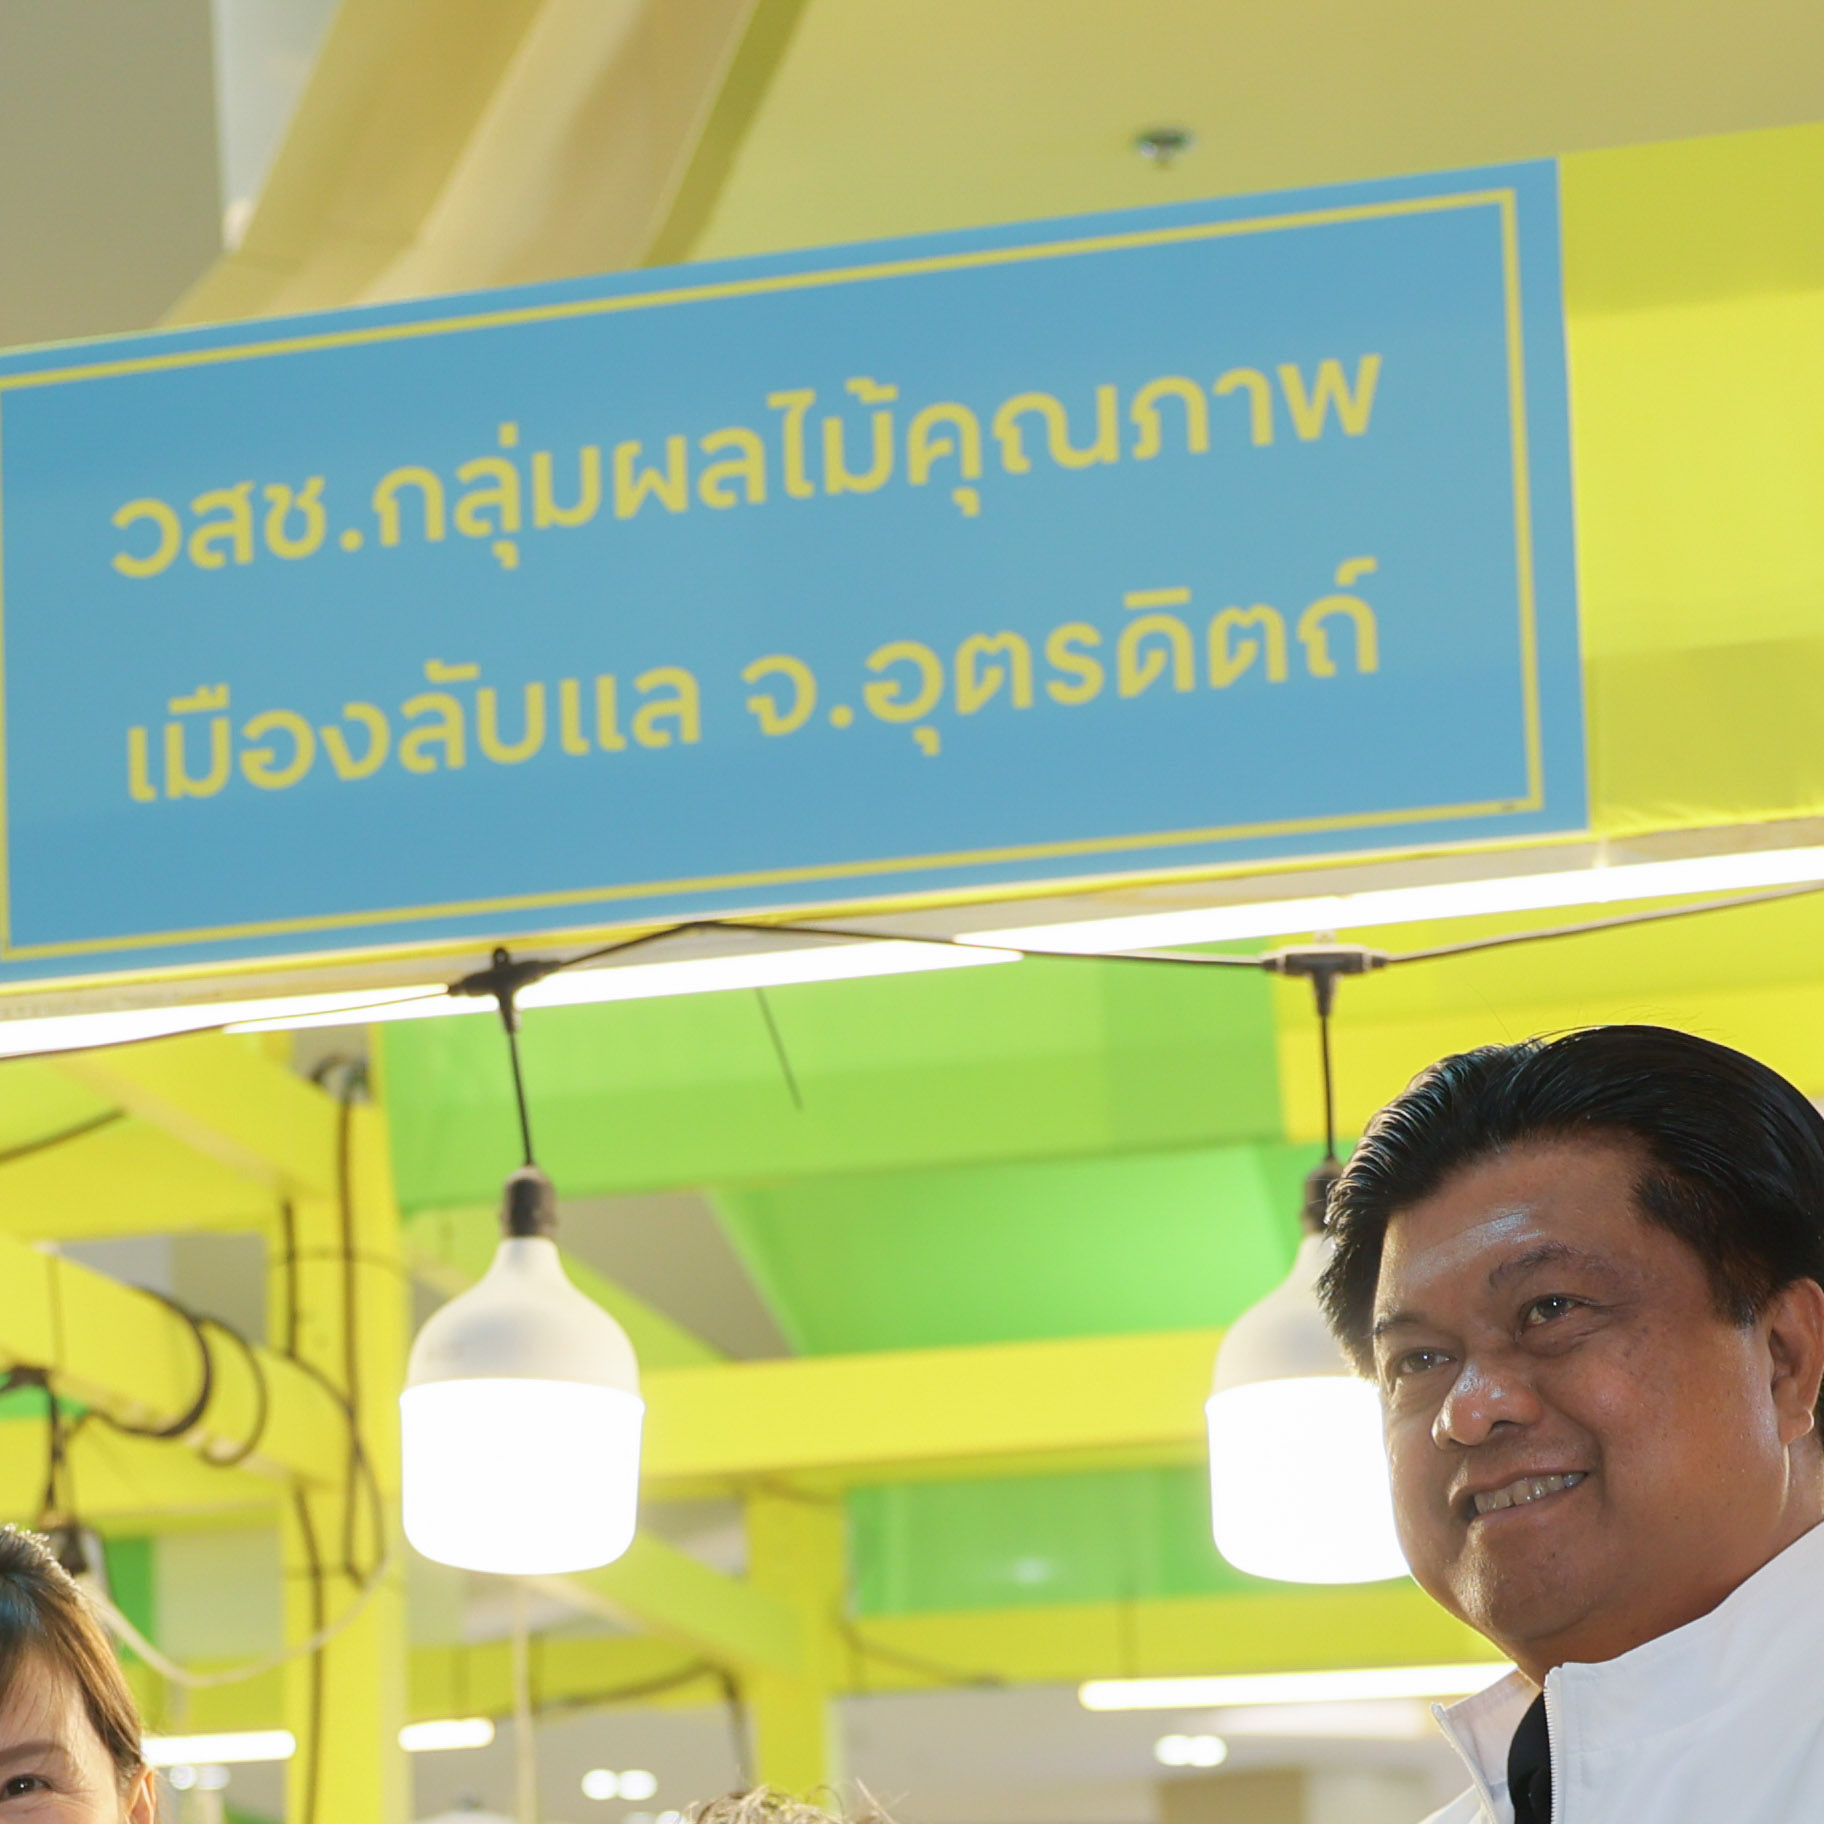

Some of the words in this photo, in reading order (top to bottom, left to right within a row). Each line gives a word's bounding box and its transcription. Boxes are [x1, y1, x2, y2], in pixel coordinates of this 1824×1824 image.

[111, 353, 1383, 579] วสช.กลุ่มผลไม้คุณภาพ
[127, 659, 702, 802] เมืองลับแล
[740, 555, 1379, 757] จ.อุตรดิตถ์
